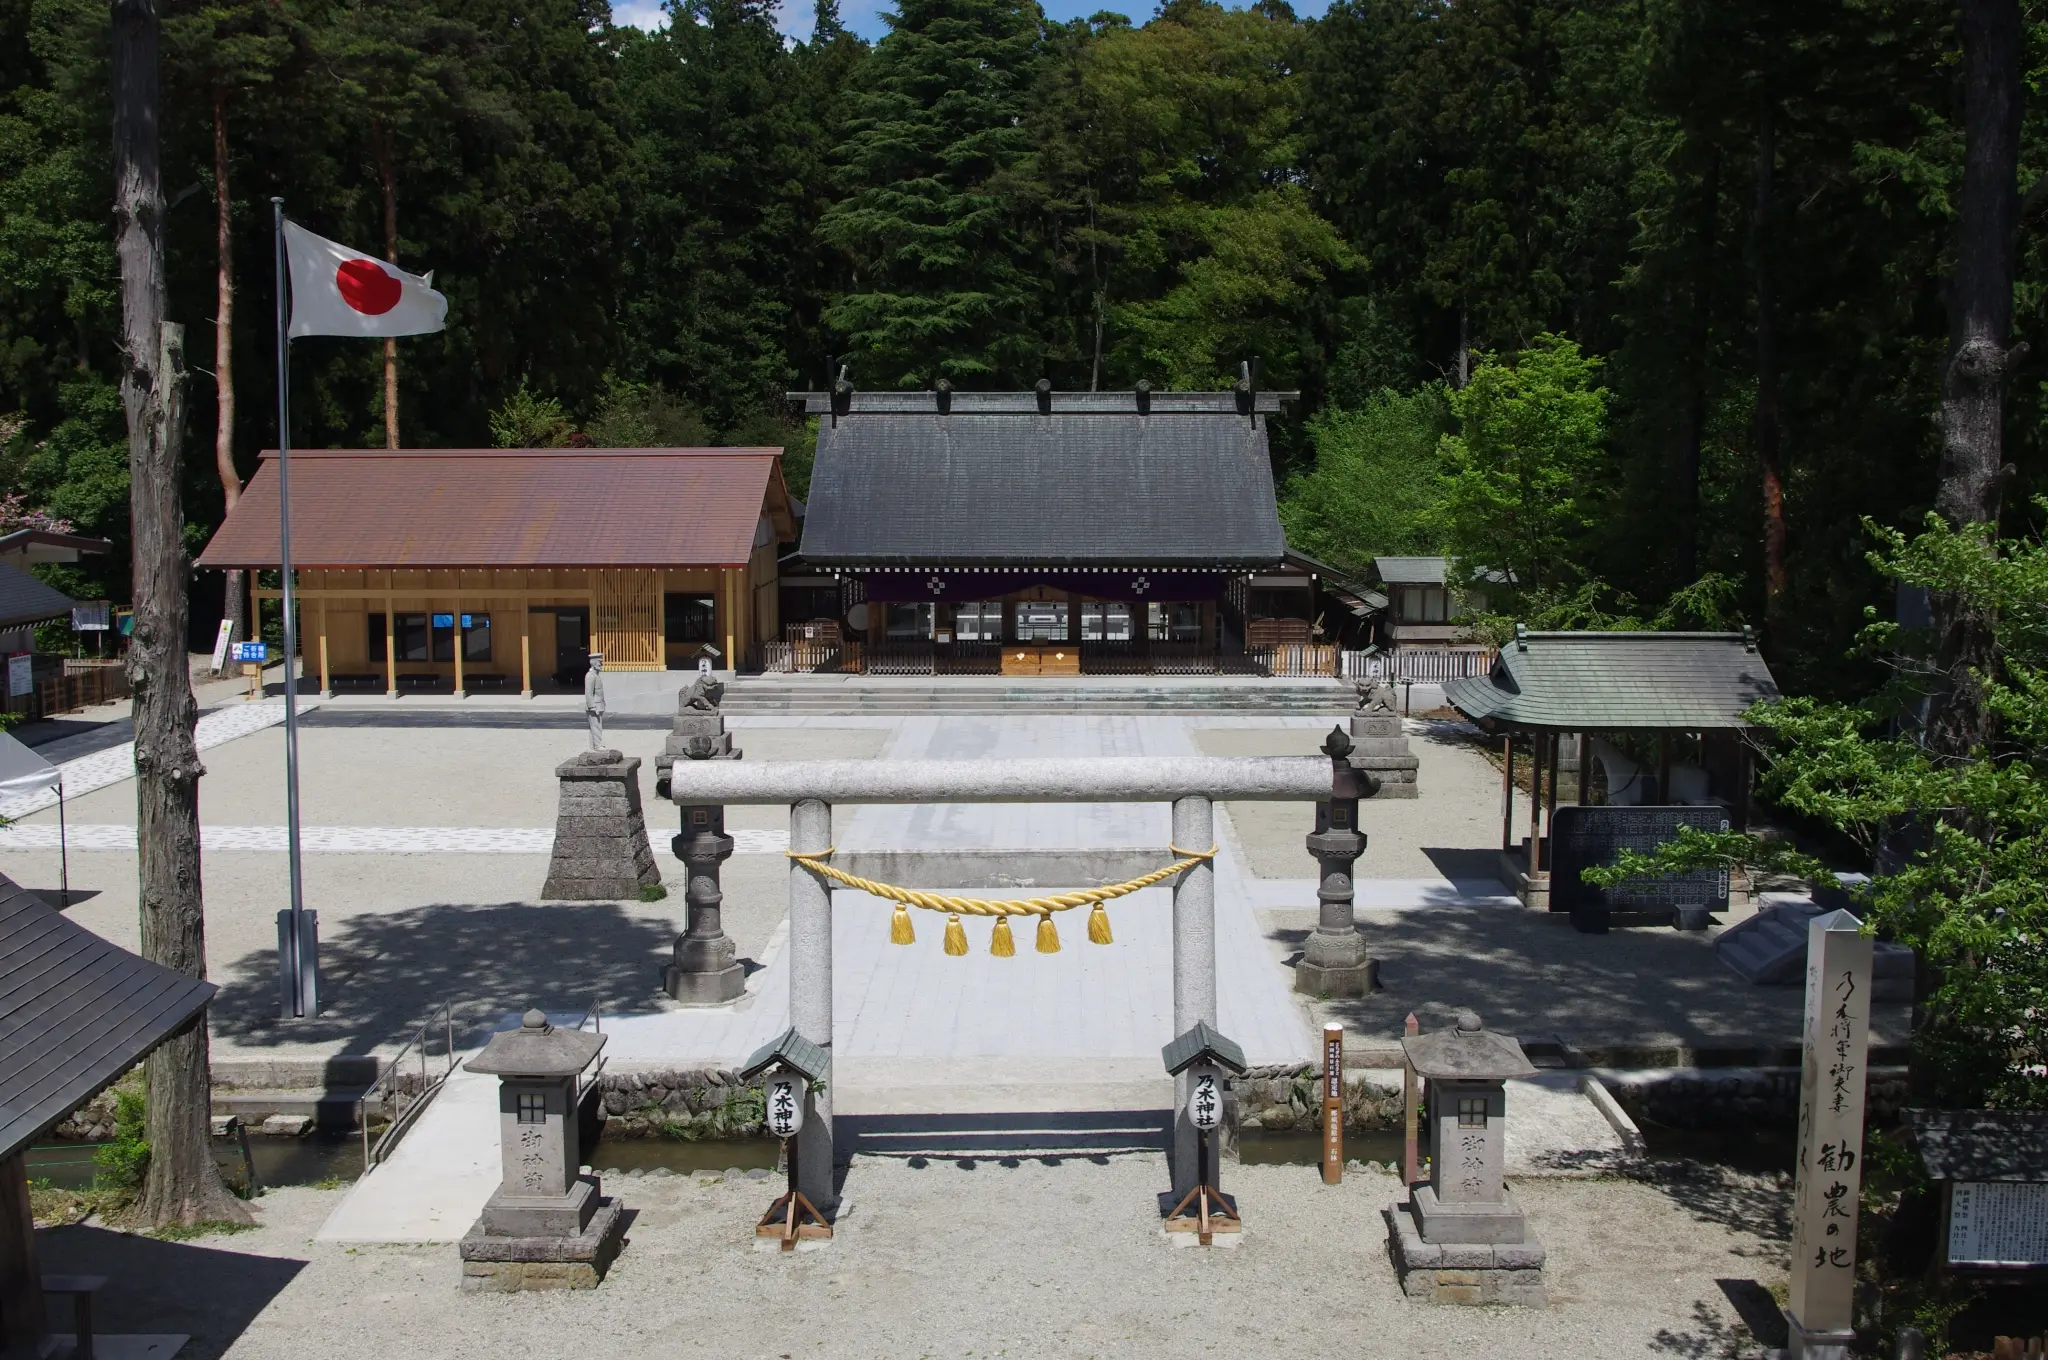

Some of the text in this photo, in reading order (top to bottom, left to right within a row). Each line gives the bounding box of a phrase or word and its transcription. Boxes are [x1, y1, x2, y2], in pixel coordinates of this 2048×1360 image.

[1829, 970, 1859, 1113] 乃木将軍御夫妻
[773, 1082, 795, 1135] 乃木神社
[1195, 1074, 1215, 1127] 乃木神社
[520, 1130, 544, 1190] 御神前
[1330, 1148, 1338, 1162] 石林
[1461, 1135, 1486, 1195] 御神前
[1814, 1139, 1856, 1269] 勧農の地
